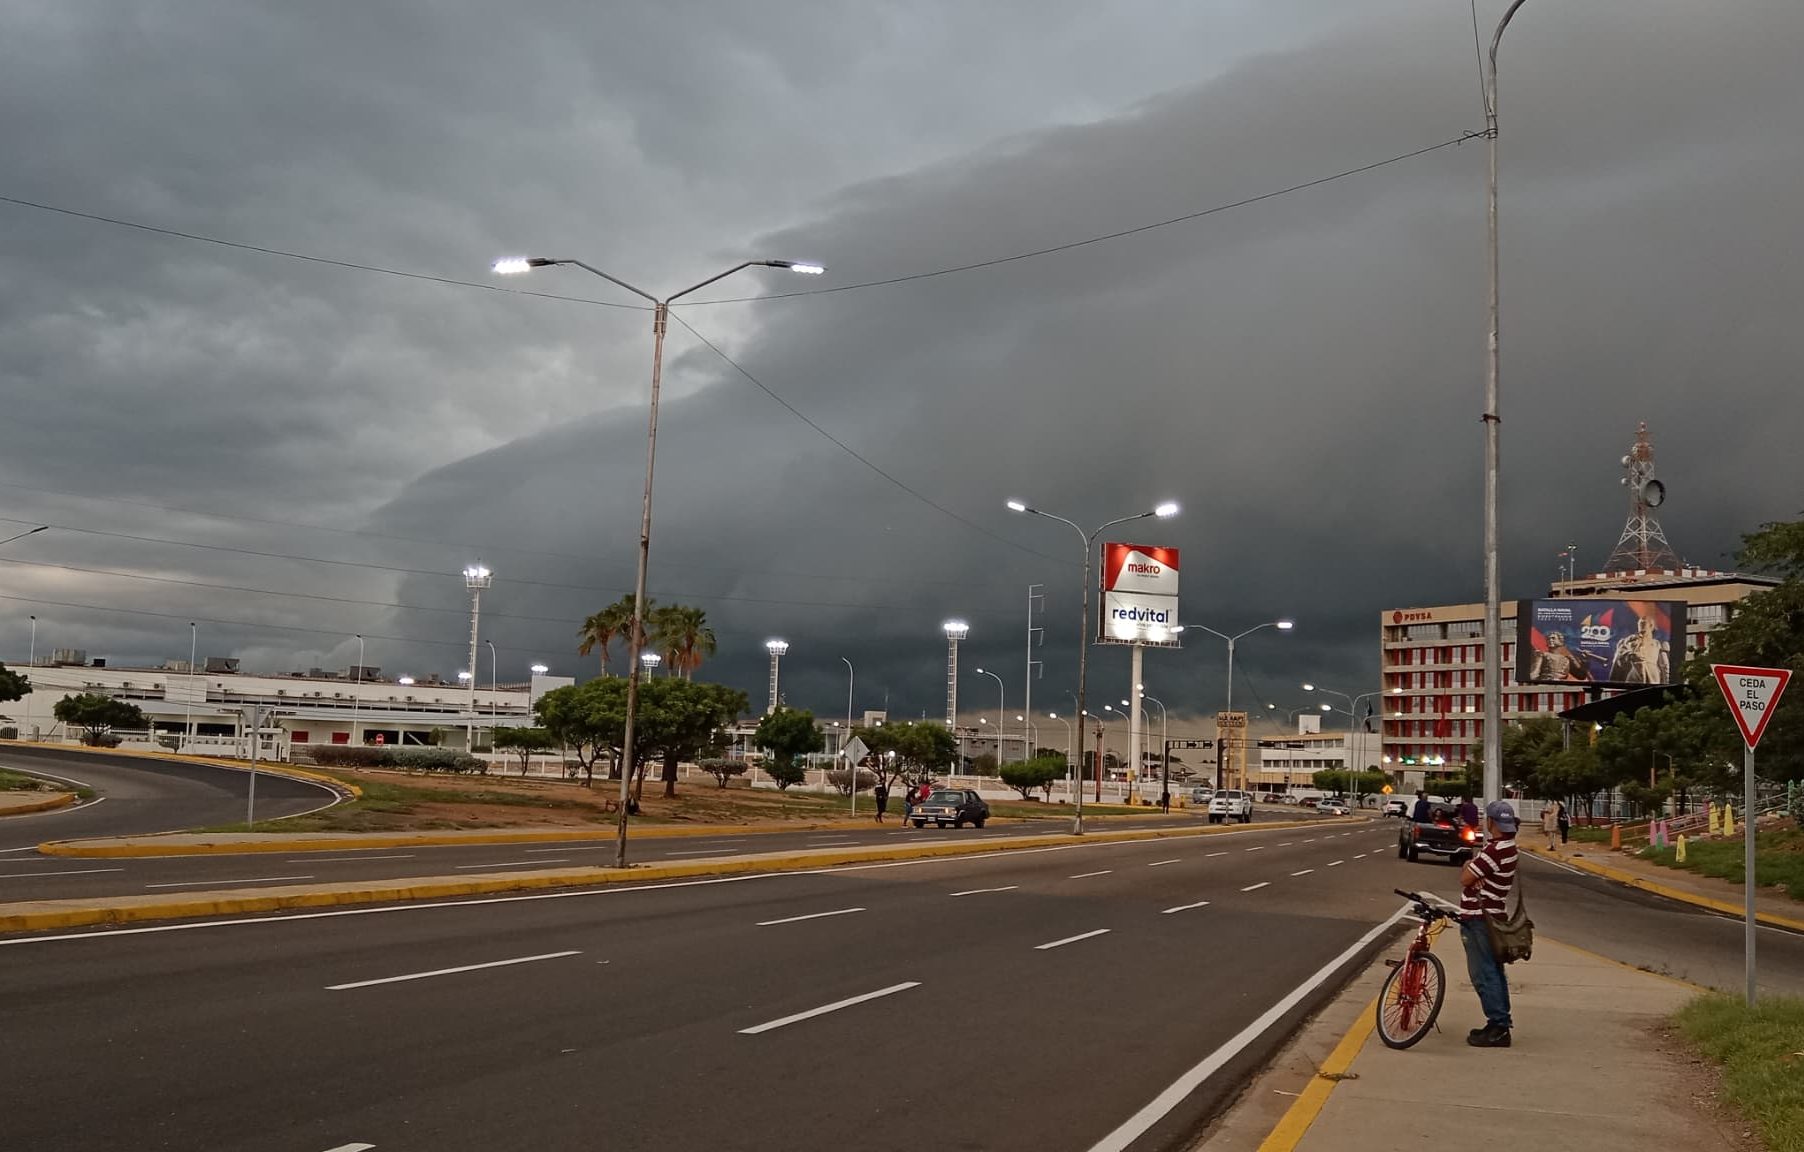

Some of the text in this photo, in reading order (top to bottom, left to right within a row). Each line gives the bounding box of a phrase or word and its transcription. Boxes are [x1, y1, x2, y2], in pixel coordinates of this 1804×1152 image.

[1127, 563, 1160, 574] makro
[1112, 607, 1169, 623] redvital
[1404, 612, 1432, 621] PDVSA
[1581, 625, 1611, 641] 200
[1739, 678, 1766, 688] CEDA
[1746, 690, 1759, 699] EL
[1740, 700, 1765, 711] PASO
